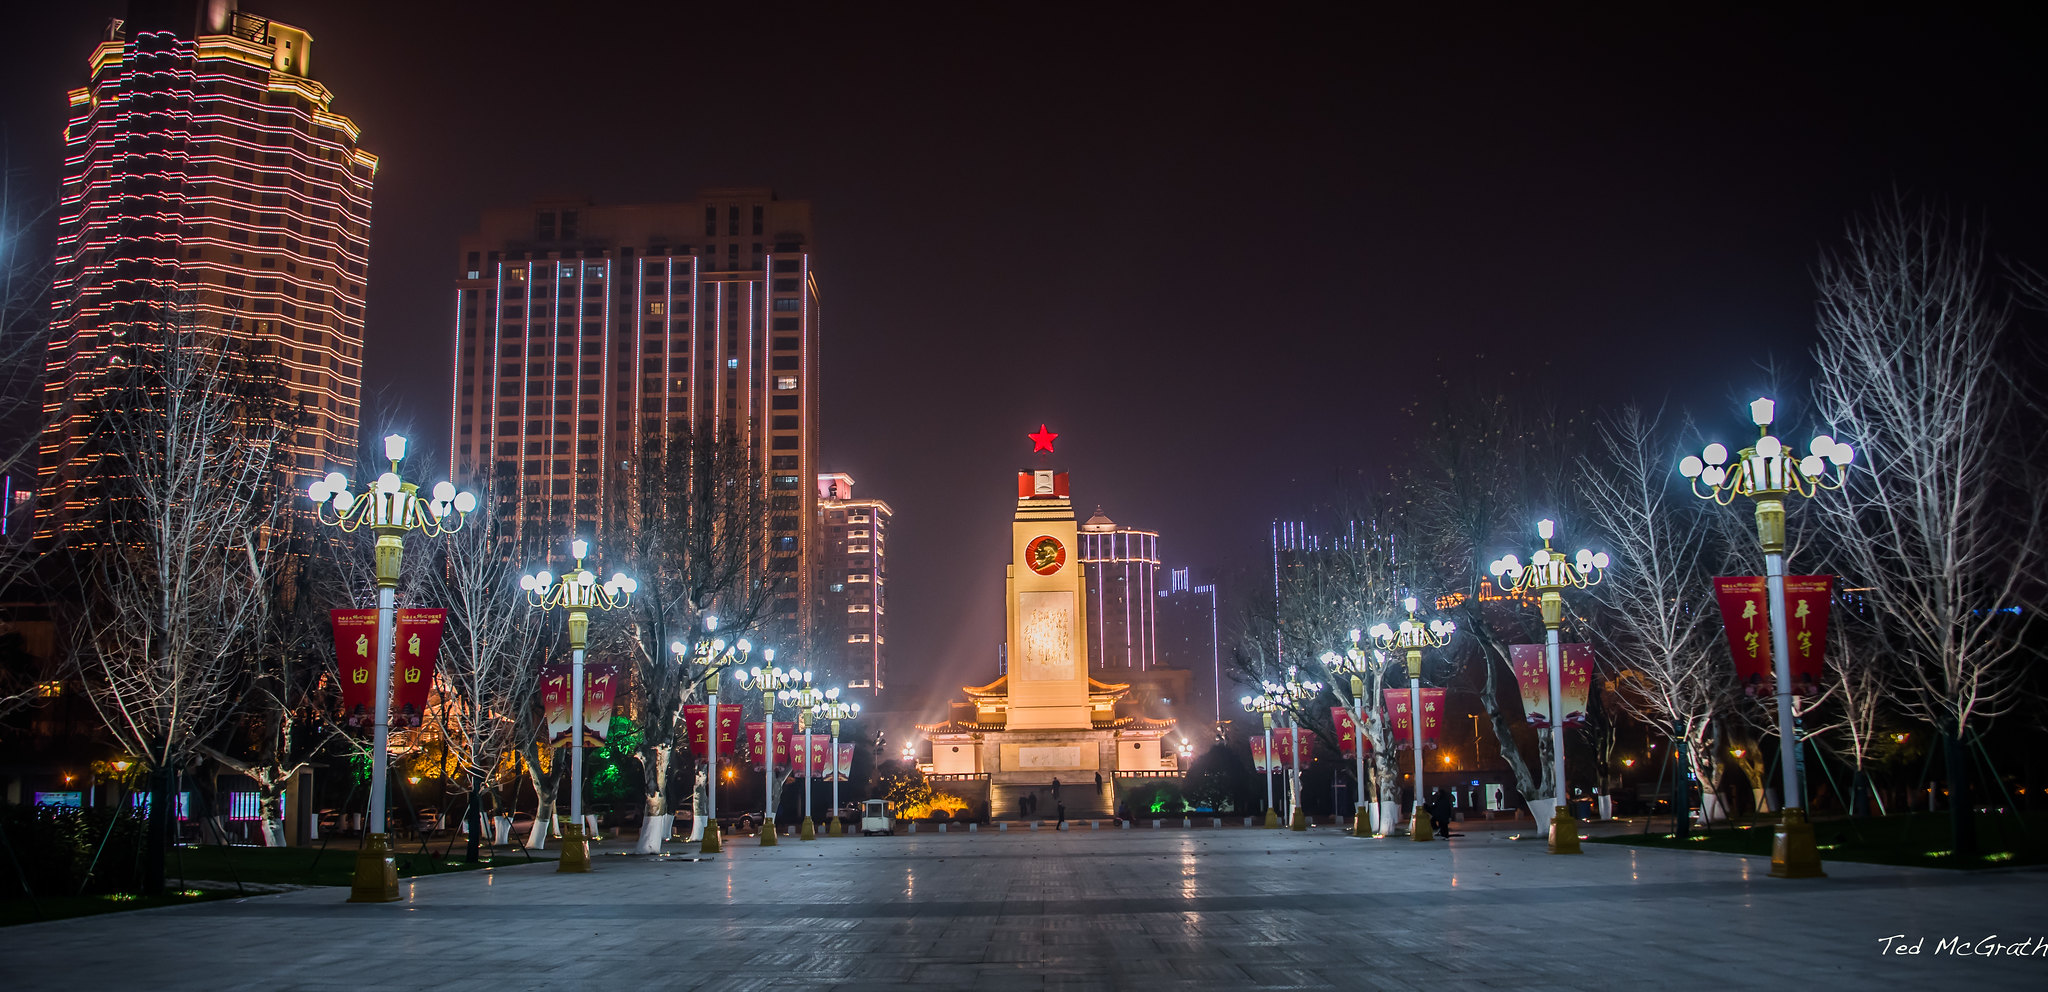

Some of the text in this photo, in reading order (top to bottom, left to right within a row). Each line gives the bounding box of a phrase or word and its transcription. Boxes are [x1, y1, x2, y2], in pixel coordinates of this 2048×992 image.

[1741, 599, 1760, 658] 平等
[1794, 599, 1812, 658] 平等
[352, 633, 369, 684] 自由
[404, 632, 421, 683] 自由
[694, 718, 706, 743] 公正
[720, 717, 732, 742] 公正
